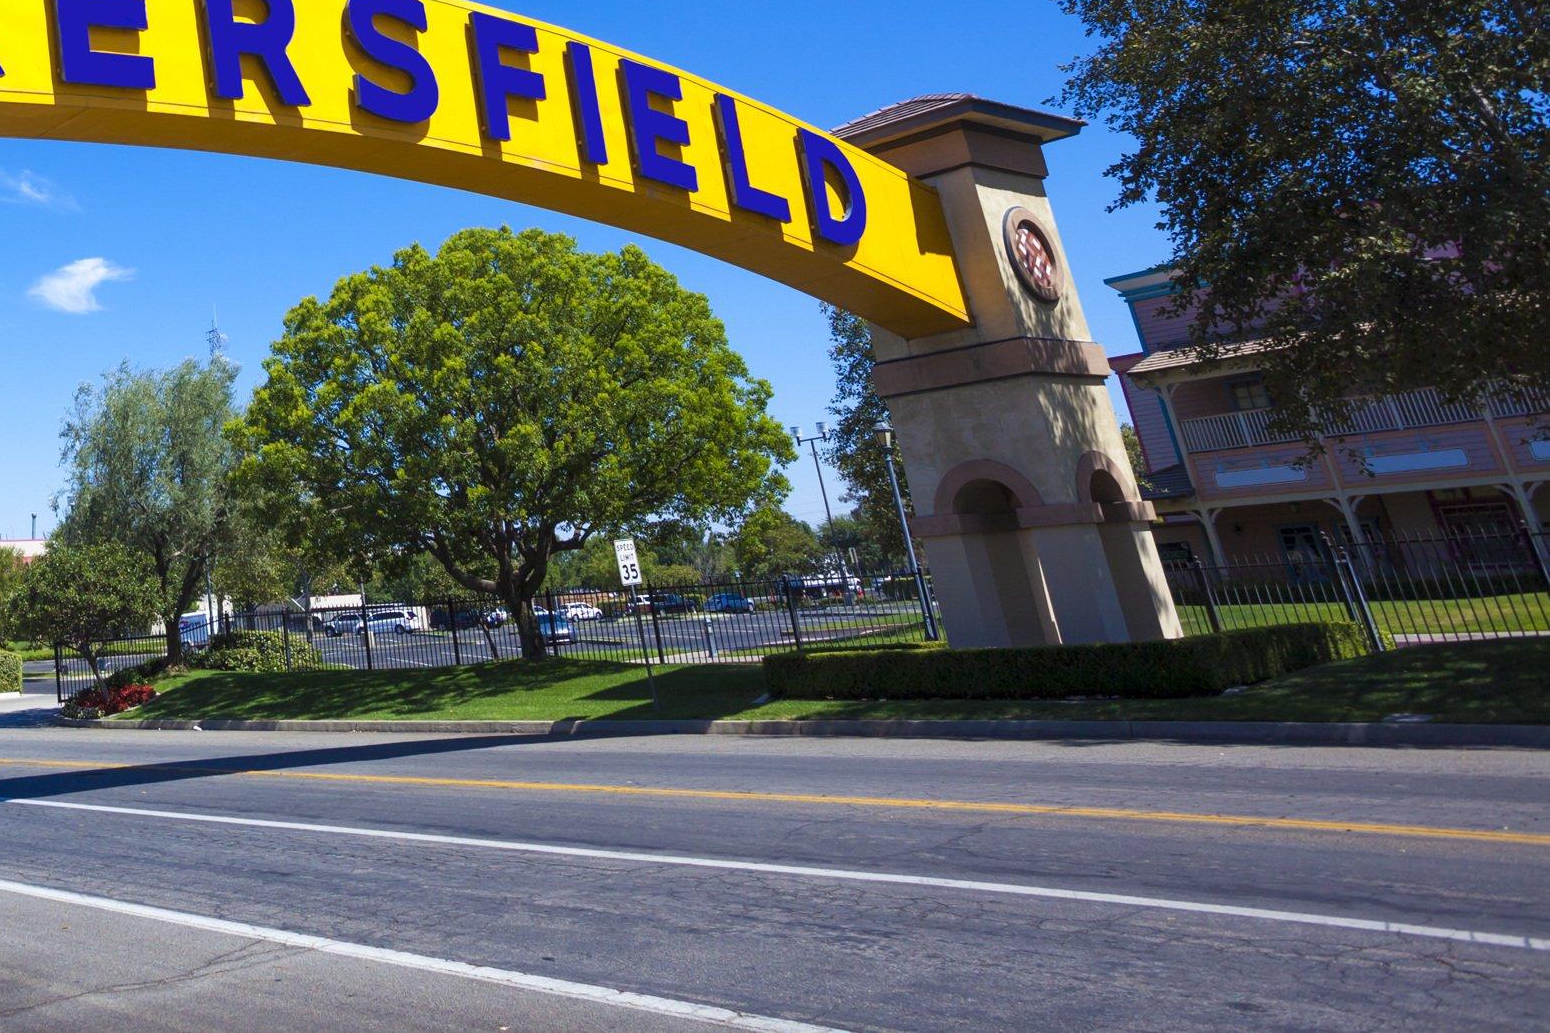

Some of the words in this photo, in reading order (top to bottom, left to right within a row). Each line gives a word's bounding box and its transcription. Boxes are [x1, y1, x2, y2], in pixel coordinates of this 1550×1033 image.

[616, 543, 634, 551] SPEED
[619, 553, 635, 562] LIMIT
[622, 563, 639, 581] 35
